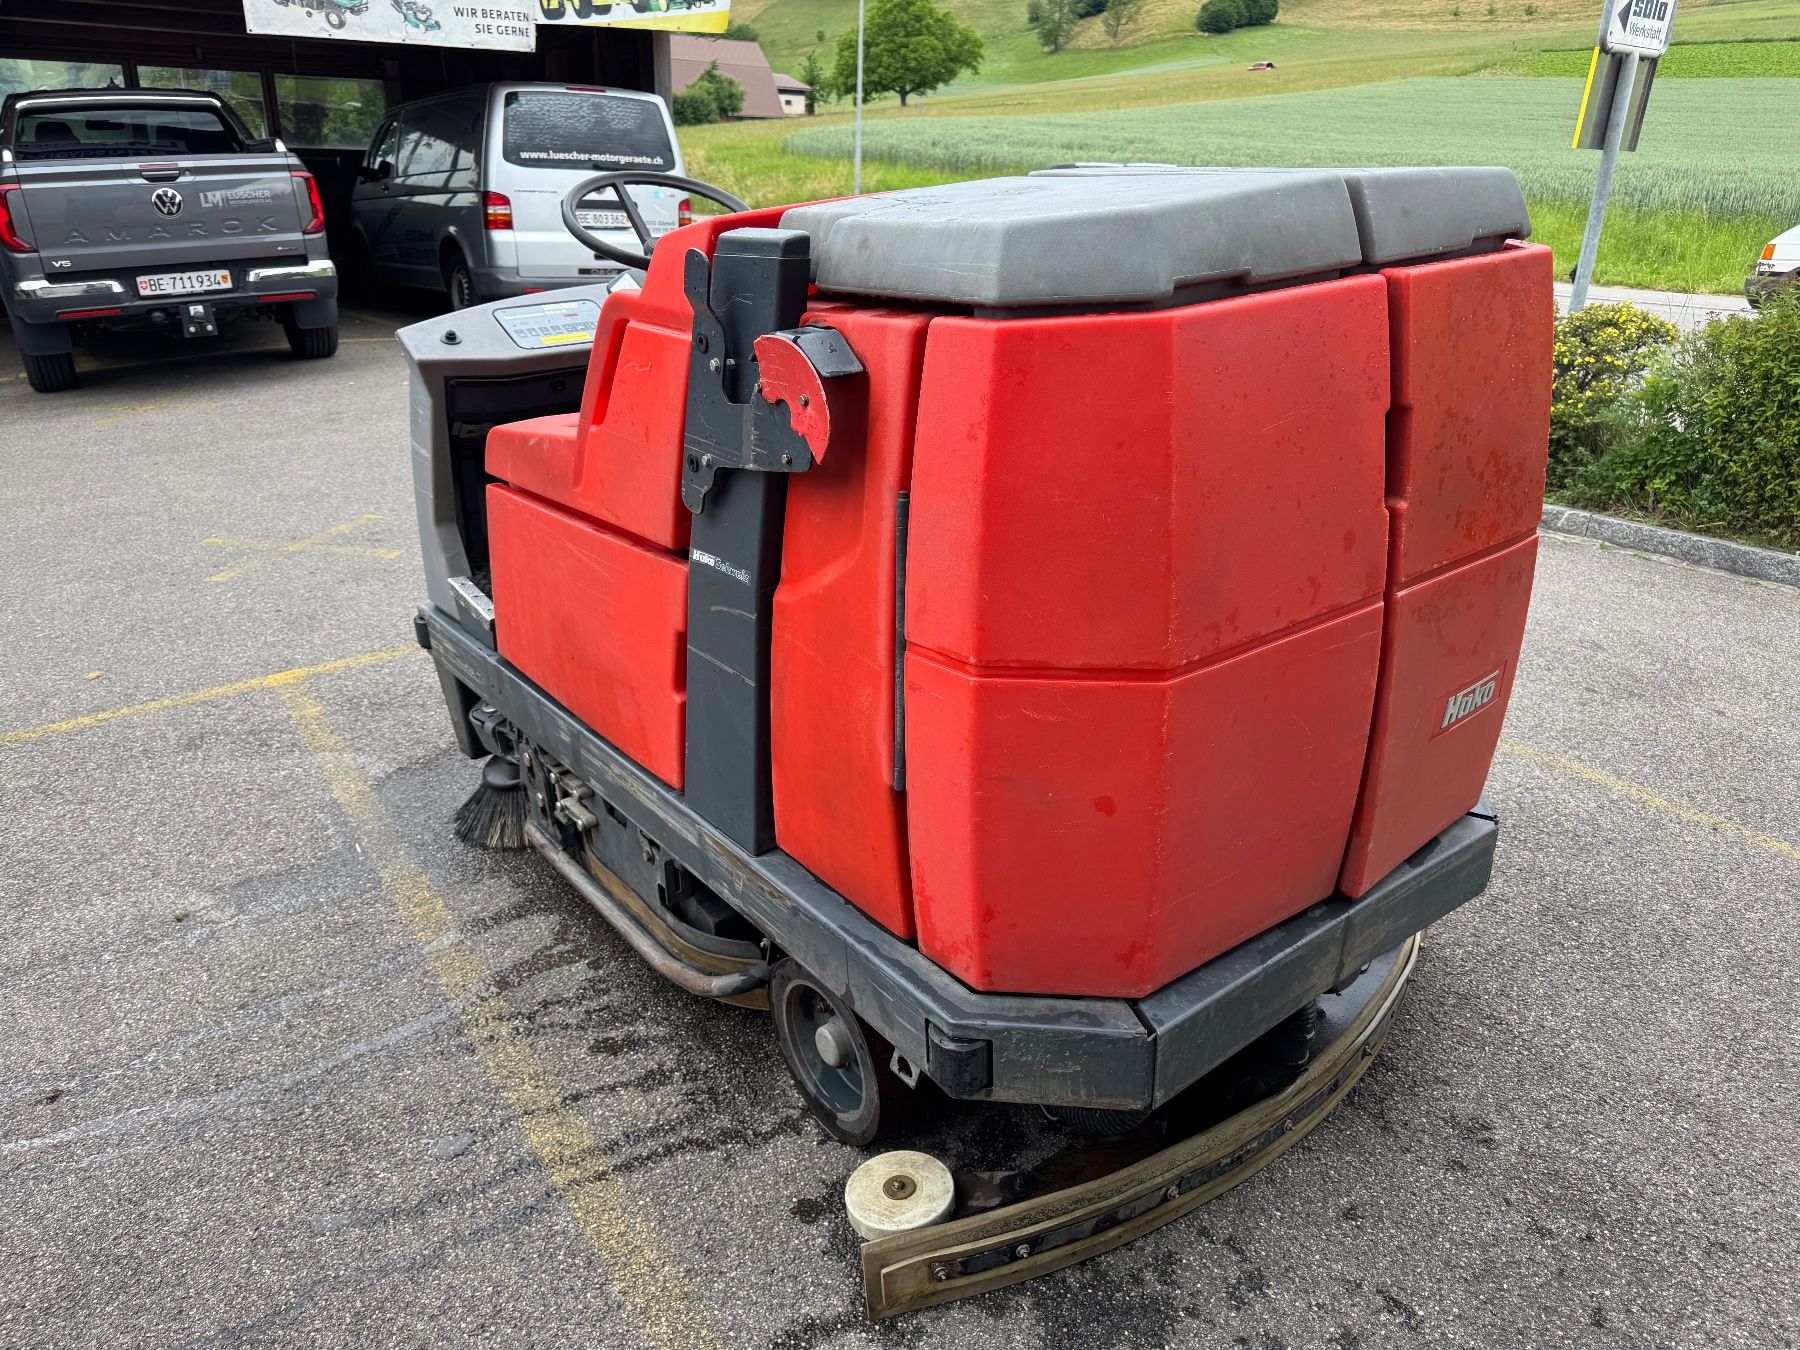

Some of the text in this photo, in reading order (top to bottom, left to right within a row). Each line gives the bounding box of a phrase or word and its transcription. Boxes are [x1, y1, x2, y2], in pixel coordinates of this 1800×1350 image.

[453, 6, 530, 22] WIR BERATEN
[475, 23, 531, 38] SIE GERNE
[1629, 21, 1662, 41] Werkstatt
[519, 150, 664, 165] www.luescher-motorgeraete.ch
[64, 216, 278, 244] AMAROK
[693, 549, 716, 567] Hako
[1440, 669, 1500, 729] Hako
